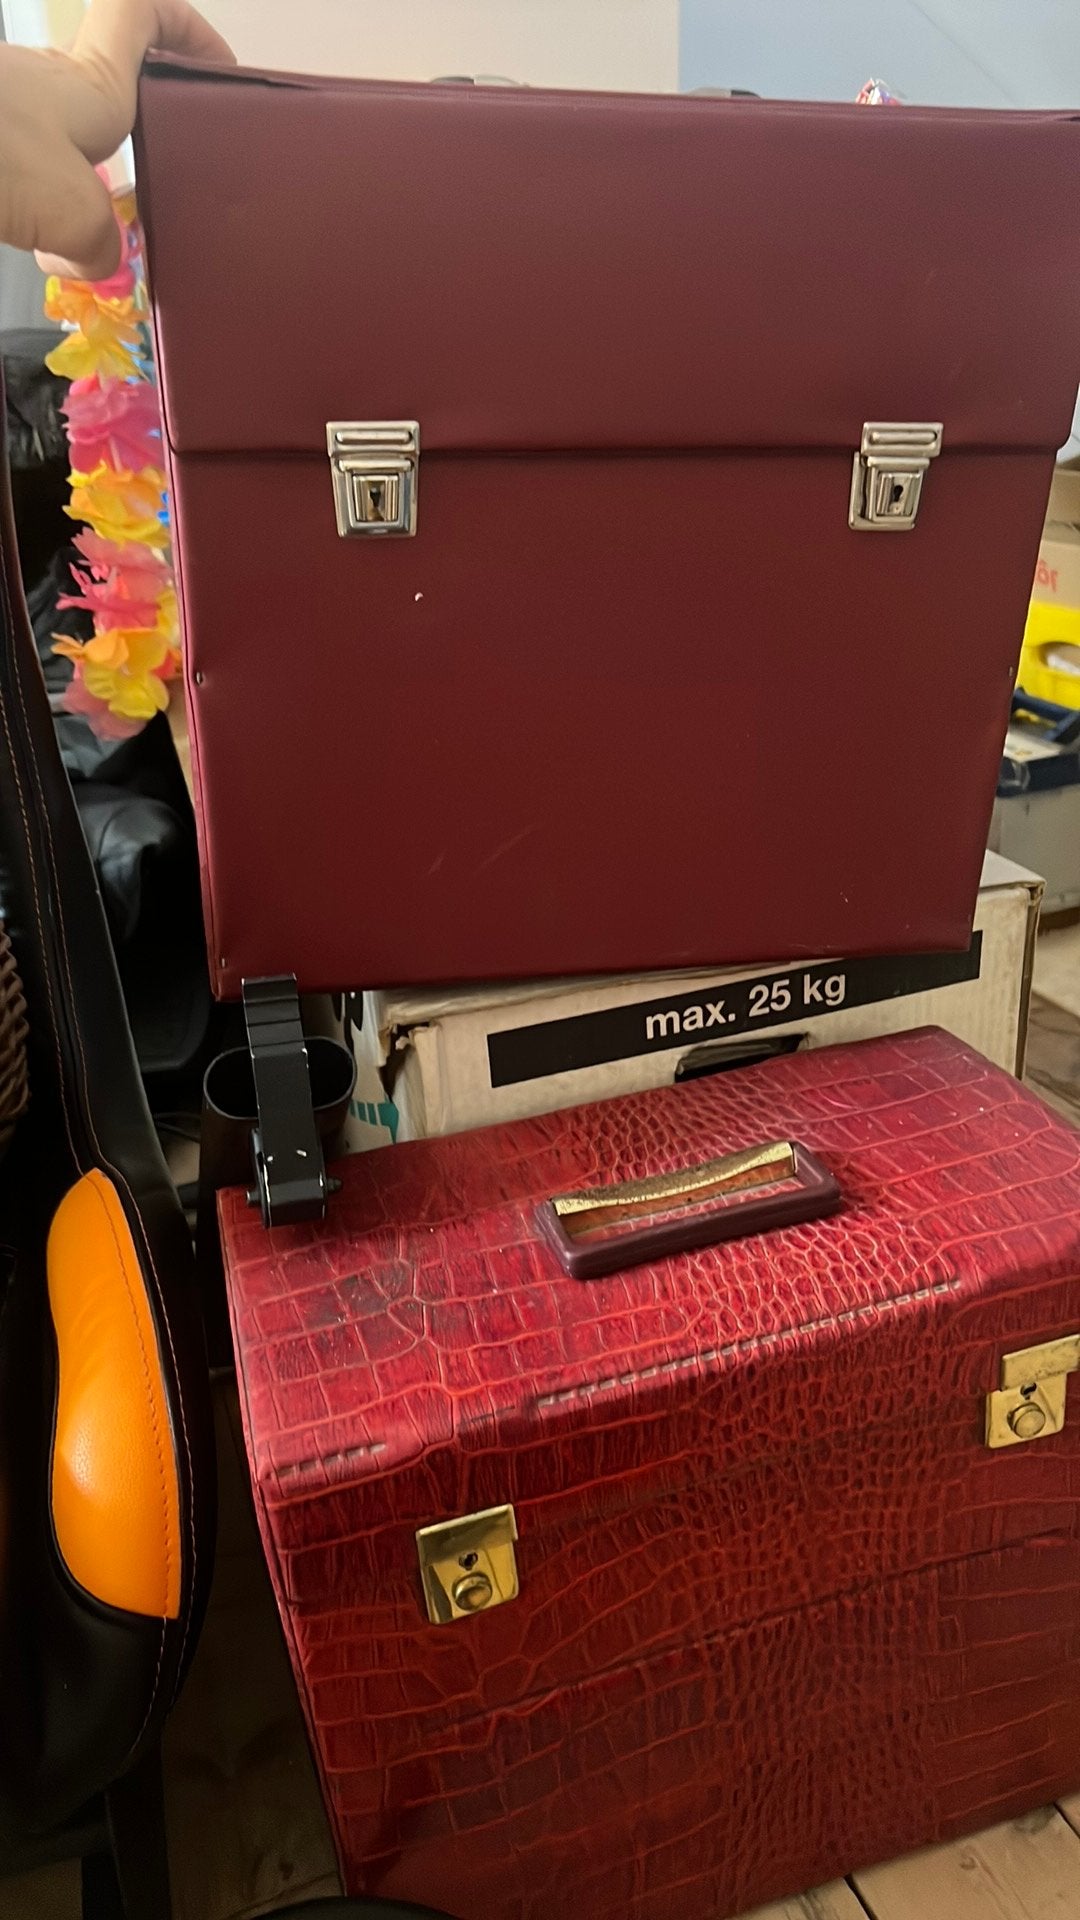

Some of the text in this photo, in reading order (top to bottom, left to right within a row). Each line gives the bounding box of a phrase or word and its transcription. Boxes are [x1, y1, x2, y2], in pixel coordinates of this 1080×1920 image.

[646, 973, 846, 1039] max. 25 kg
